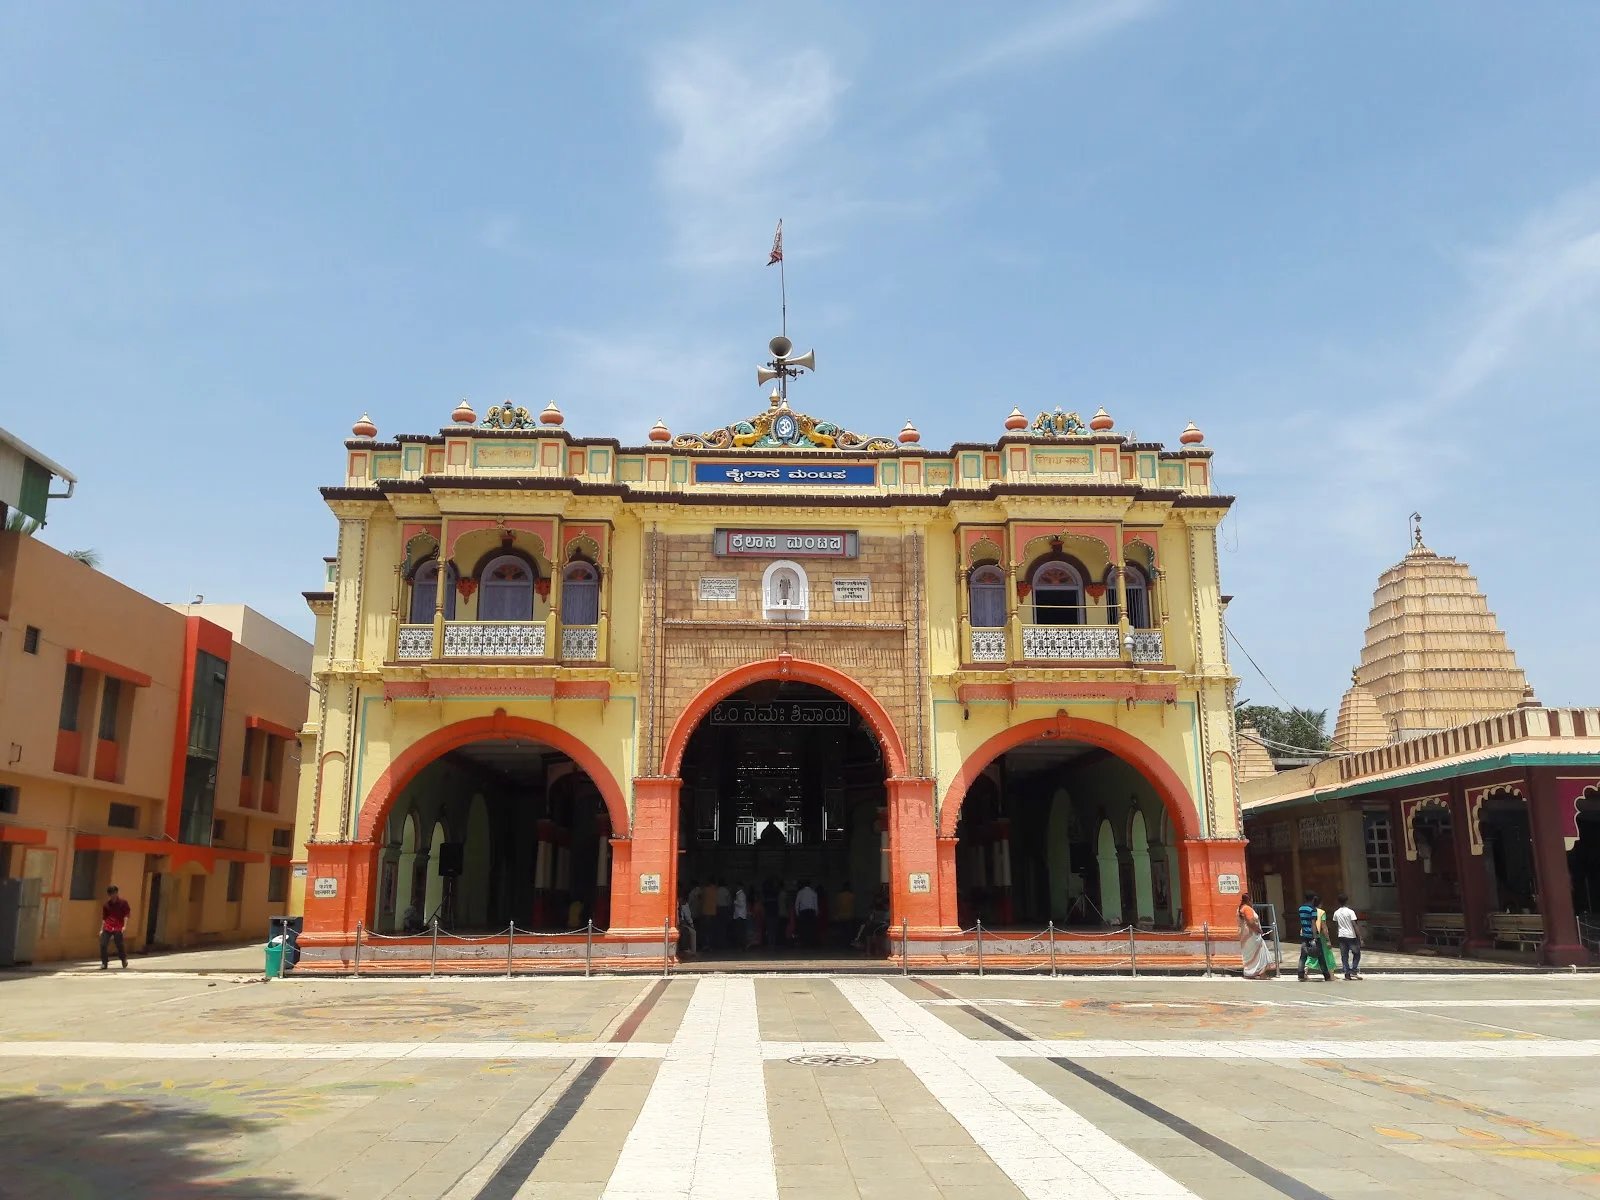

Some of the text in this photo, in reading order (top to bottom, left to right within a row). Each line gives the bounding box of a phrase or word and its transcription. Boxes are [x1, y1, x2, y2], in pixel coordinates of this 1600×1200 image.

[725, 468, 847, 482] ಕೈಲಾಸ ಮಂಟಪ
[732, 534, 841, 552] ಕೈಲಾಸ ಮಂಟಪ
[713, 703, 847, 722] ಓಂ ನಮಃ ಶಿವಾಯ
